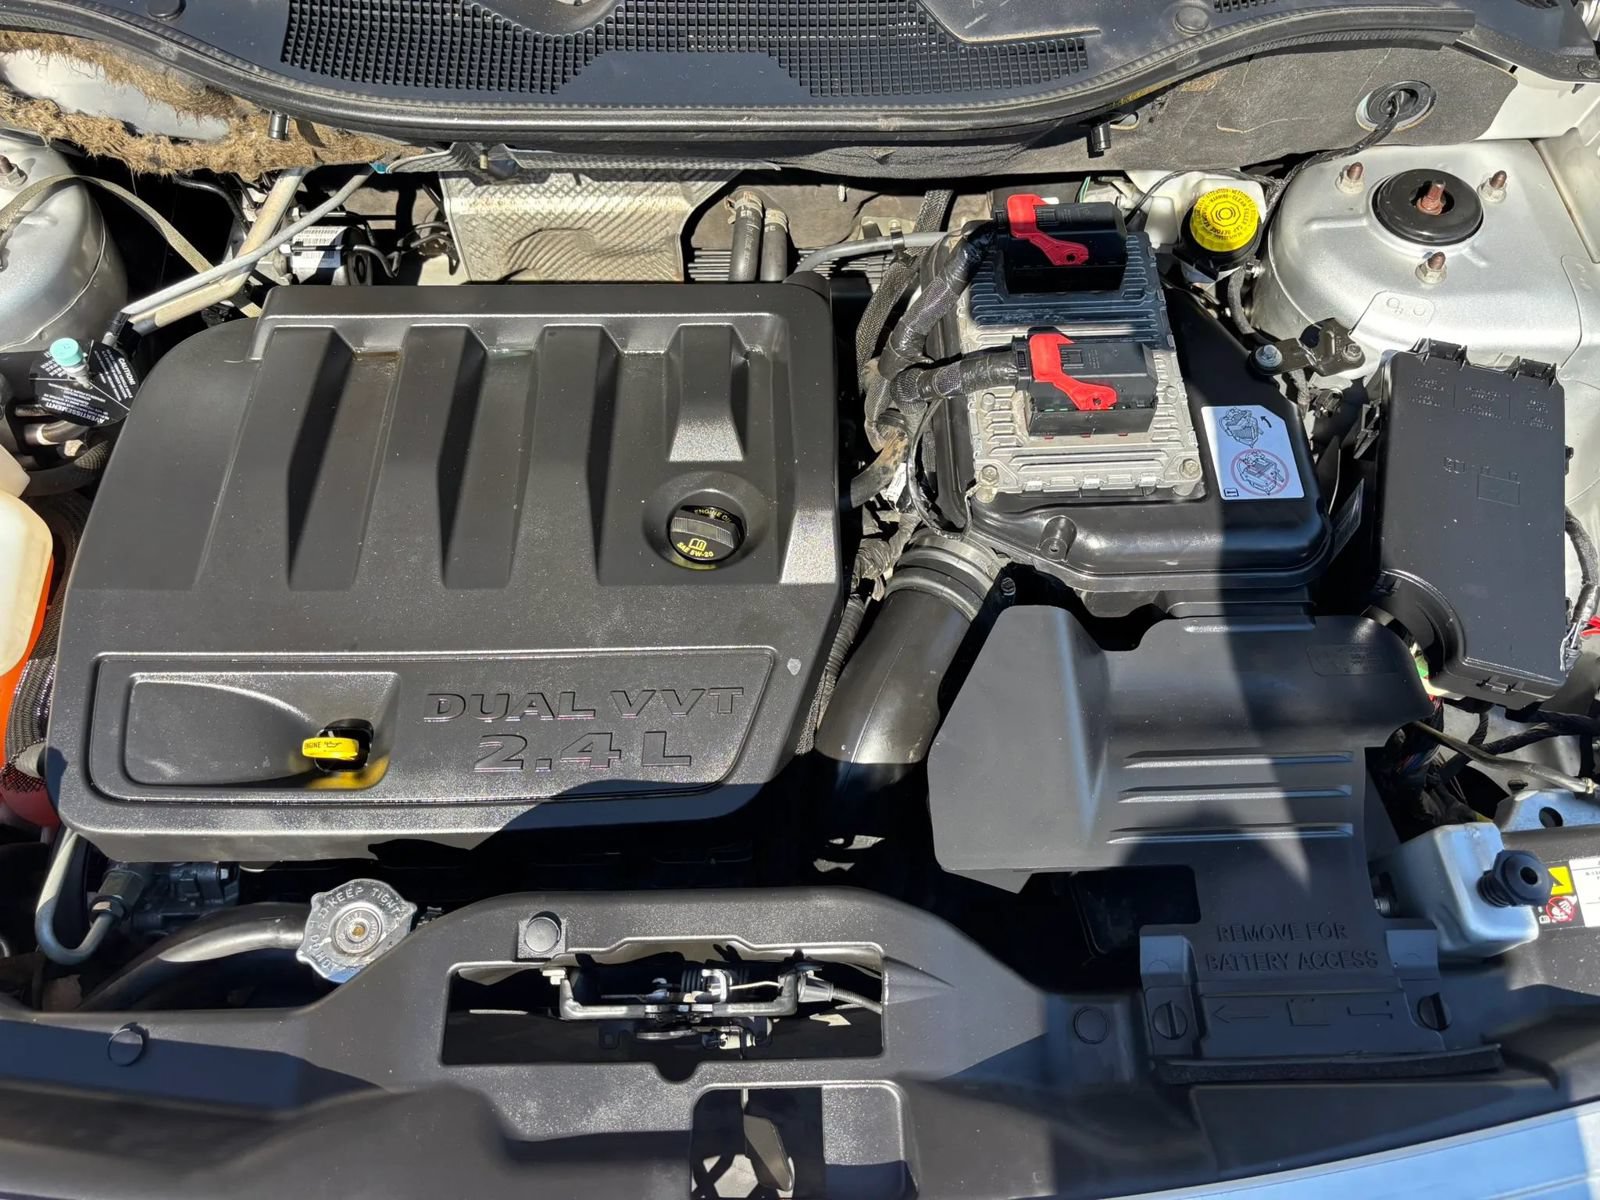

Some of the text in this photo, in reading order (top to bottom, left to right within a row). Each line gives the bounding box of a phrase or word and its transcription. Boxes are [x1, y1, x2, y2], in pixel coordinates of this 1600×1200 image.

[118, 357, 137, 386] CAUTION!
[677, 542, 691, 553] SAE
[423, 686, 745, 722] DUAL VVT
[1216, 921, 1349, 943] REMOVE FOR
[1203, 950, 1379, 973] BATTERY ACCESS
